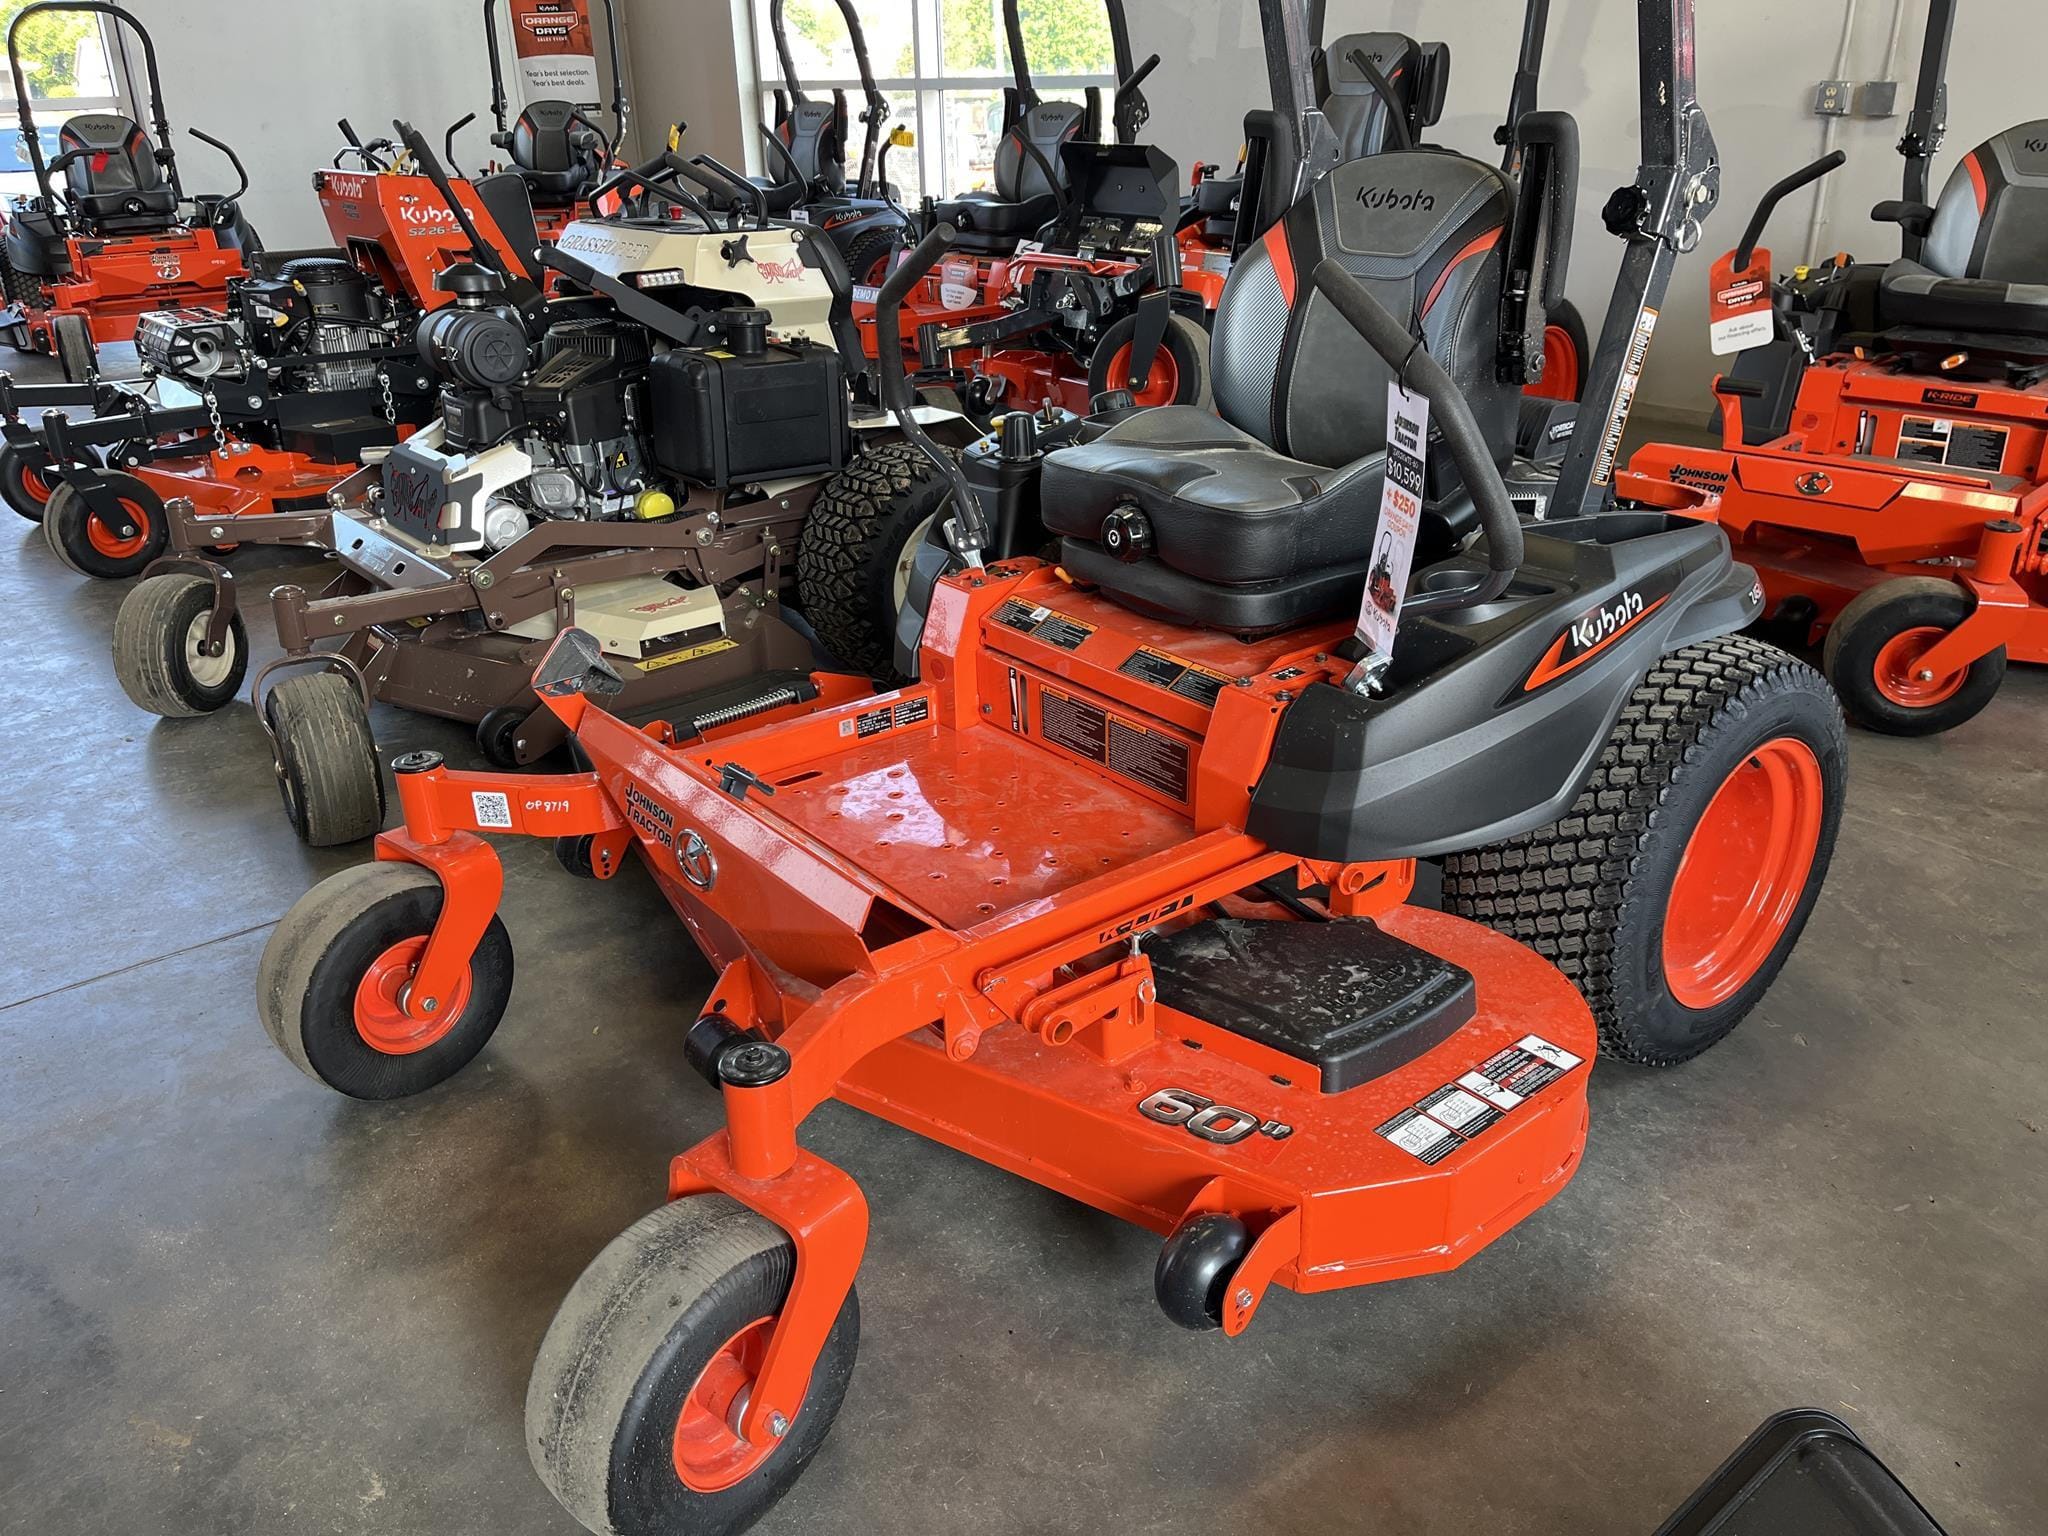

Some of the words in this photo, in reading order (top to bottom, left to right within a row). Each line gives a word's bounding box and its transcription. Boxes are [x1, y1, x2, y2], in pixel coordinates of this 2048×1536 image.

[525, 15, 575, 25] ORANGE
[536, 26, 566, 35] DAYS
[331, 175, 363, 198] Kubota
[1356, 186, 1435, 212] Kubota
[400, 206, 474, 224] Kuboa
[835, 209, 863, 222] Kubota
[409, 227, 426, 237] SZ
[853, 288, 871, 300] DEMO
[1927, 390, 1974, 403] K-RIDE
[1394, 426, 1418, 453] TRACTOR
[1387, 457, 1421, 491] $10,599
[1669, 464, 1729, 482] JOHNSON
[1393, 489, 1416, 518] $250
[1571, 591, 1644, 648] Kubota
[625, 782, 674, 829] JOHNSON
[626, 799, 673, 848] TRACTOR
[1487, 1049, 1512, 1067] DANGER
[1512, 1062, 1540, 1079] PELIGRO
[1137, 1087, 1294, 1145] 60"
